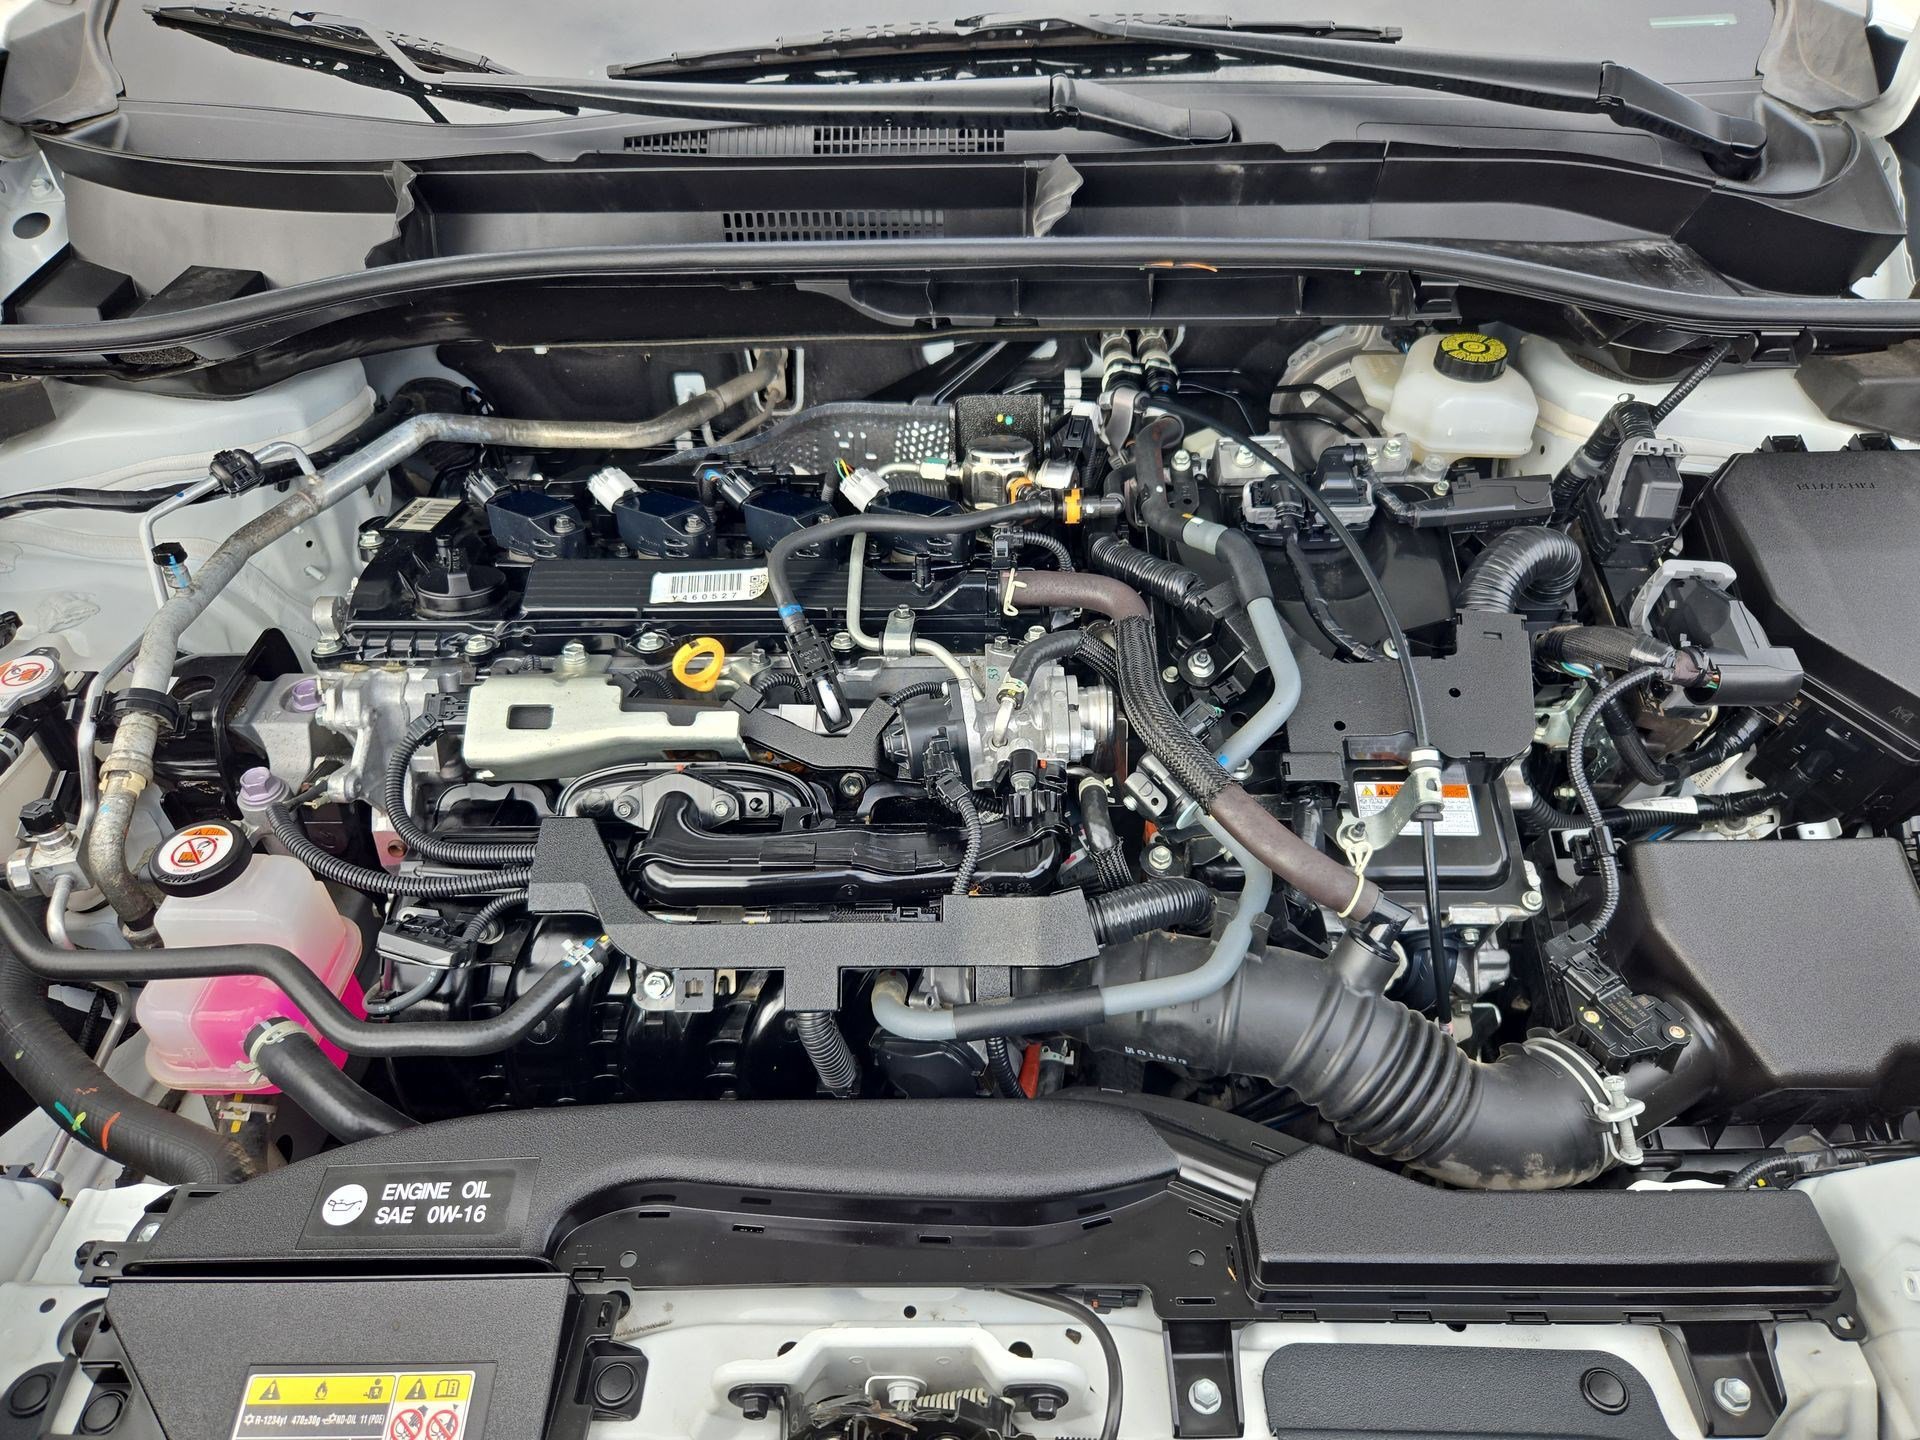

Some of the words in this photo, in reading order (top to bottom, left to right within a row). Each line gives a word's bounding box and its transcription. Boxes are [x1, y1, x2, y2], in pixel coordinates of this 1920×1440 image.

[671, 592, 738, 601] Y460527
[381, 1181, 453, 1201] ENGINE
[461, 1180, 492, 1199] OIL
[374, 1205, 417, 1225] SAE
[426, 1204, 487, 1224] 0W-16
[360, 1413, 367, 1425] 11
[367, 1413, 386, 1426] (POE)
